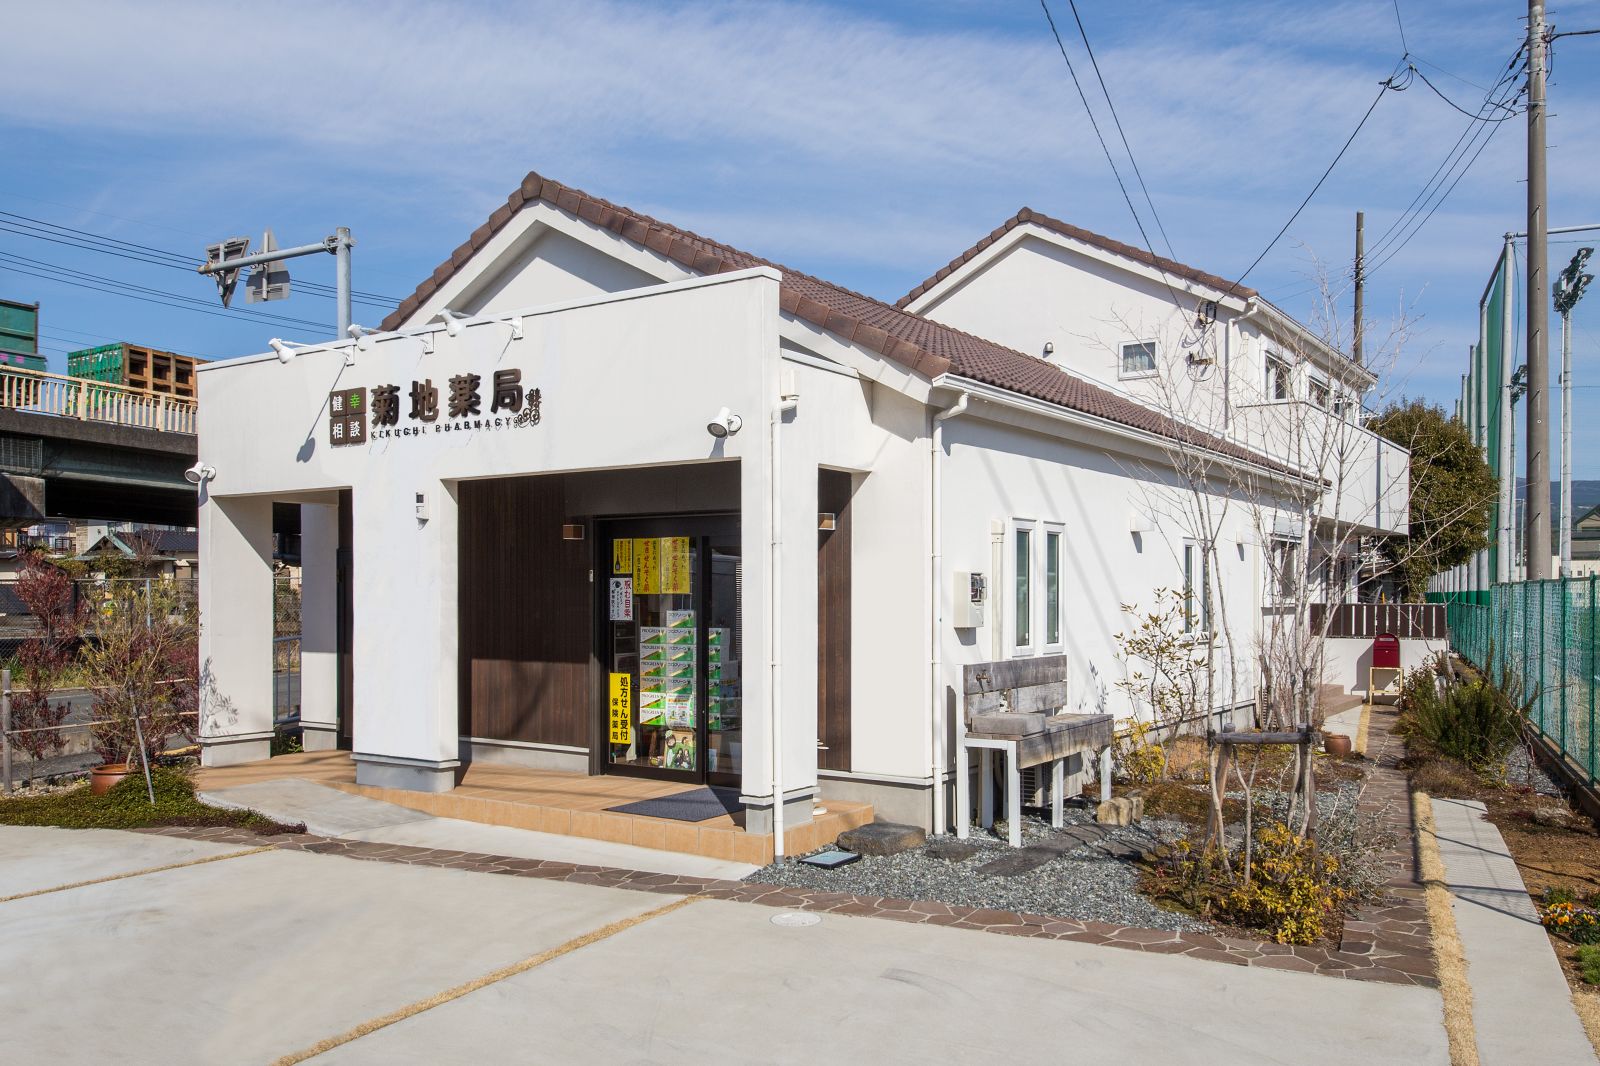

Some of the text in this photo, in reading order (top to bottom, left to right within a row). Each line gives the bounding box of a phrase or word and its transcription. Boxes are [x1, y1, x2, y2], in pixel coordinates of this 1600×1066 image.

[371, 368, 523, 426] 菊地薬局
[332, 421, 361, 439] 相談
[371, 416, 511, 440] KIKUCHI PHARMACY
[620, 676, 628, 741] 処方せん受付
